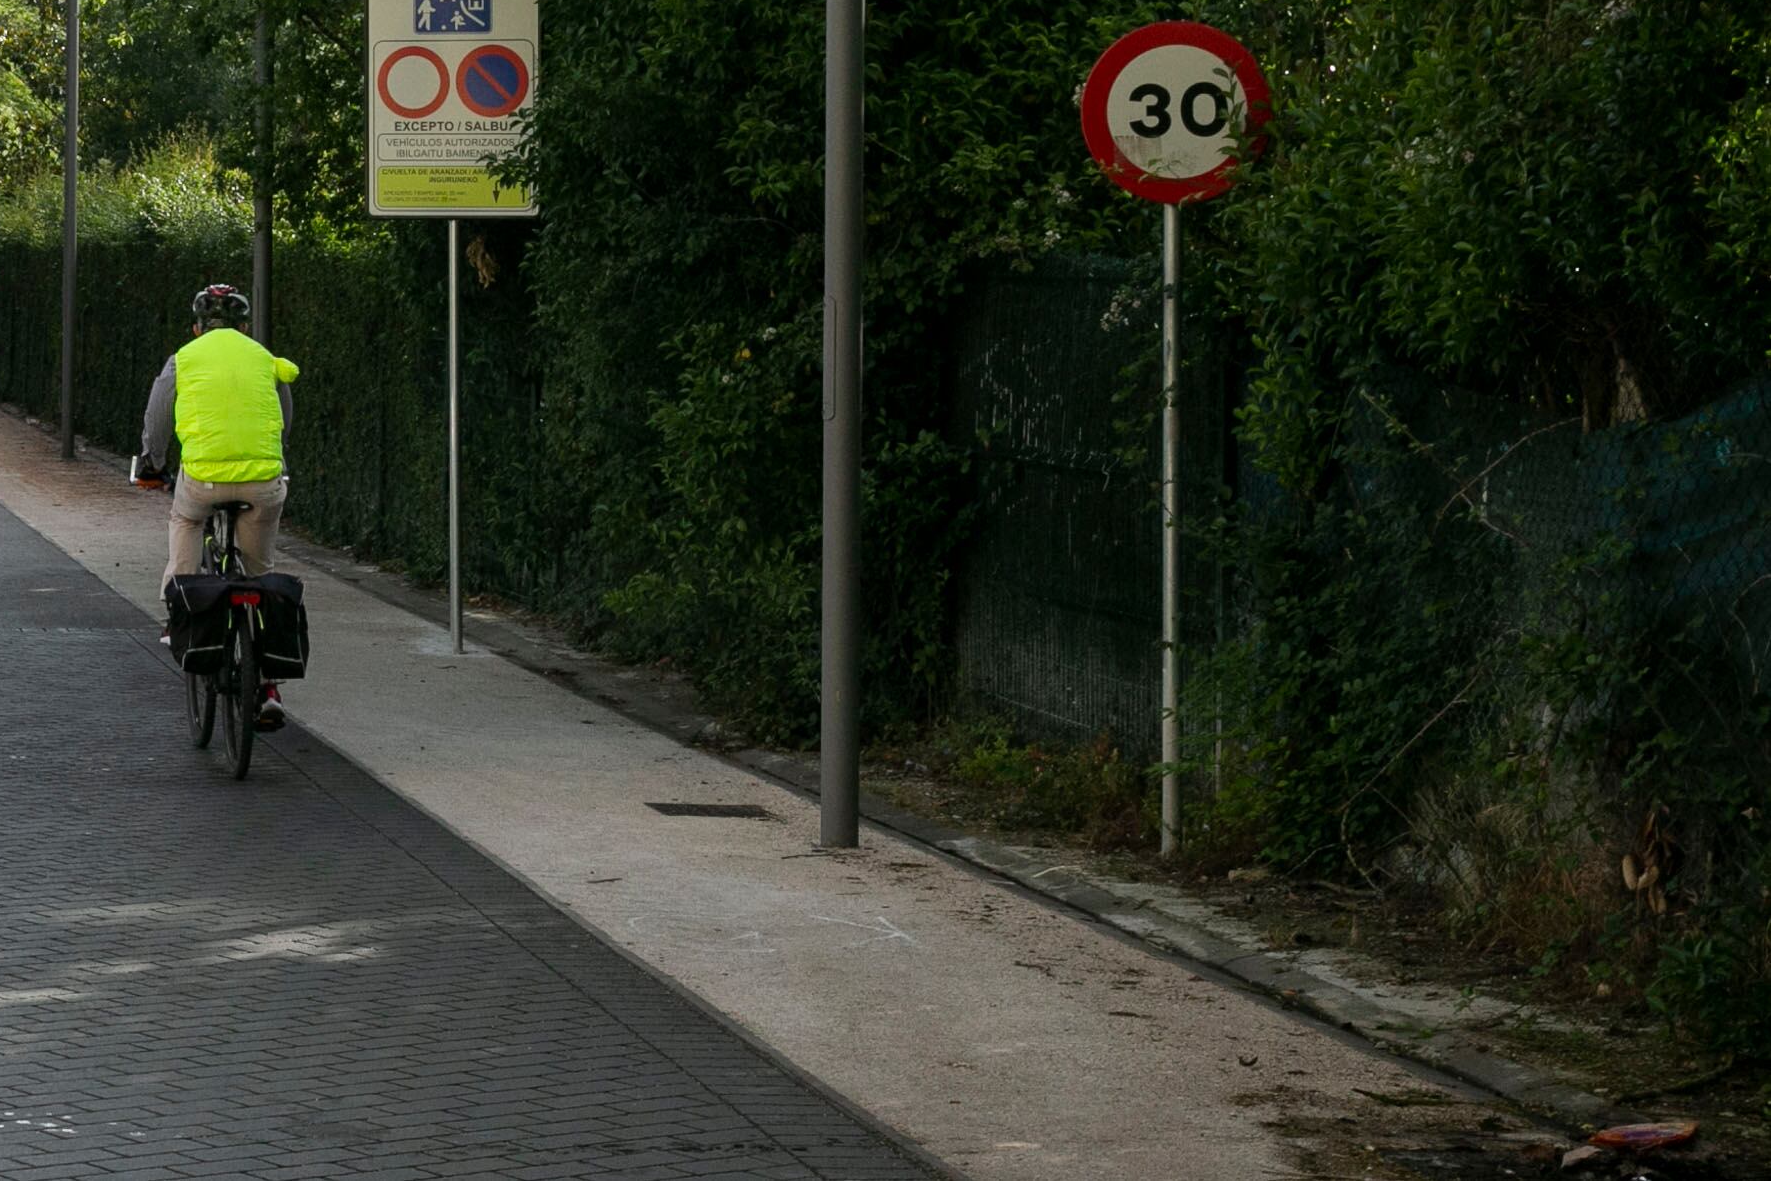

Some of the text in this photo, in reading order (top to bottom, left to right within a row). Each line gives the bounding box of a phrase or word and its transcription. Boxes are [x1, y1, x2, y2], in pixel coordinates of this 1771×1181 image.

[1129, 82, 1228, 139] 30
[394, 121, 508, 132] EXCEPTO / SALBU
[444, 138, 515, 147] AUTORIZADOS
[396, 149, 443, 158] IBILGAITU
